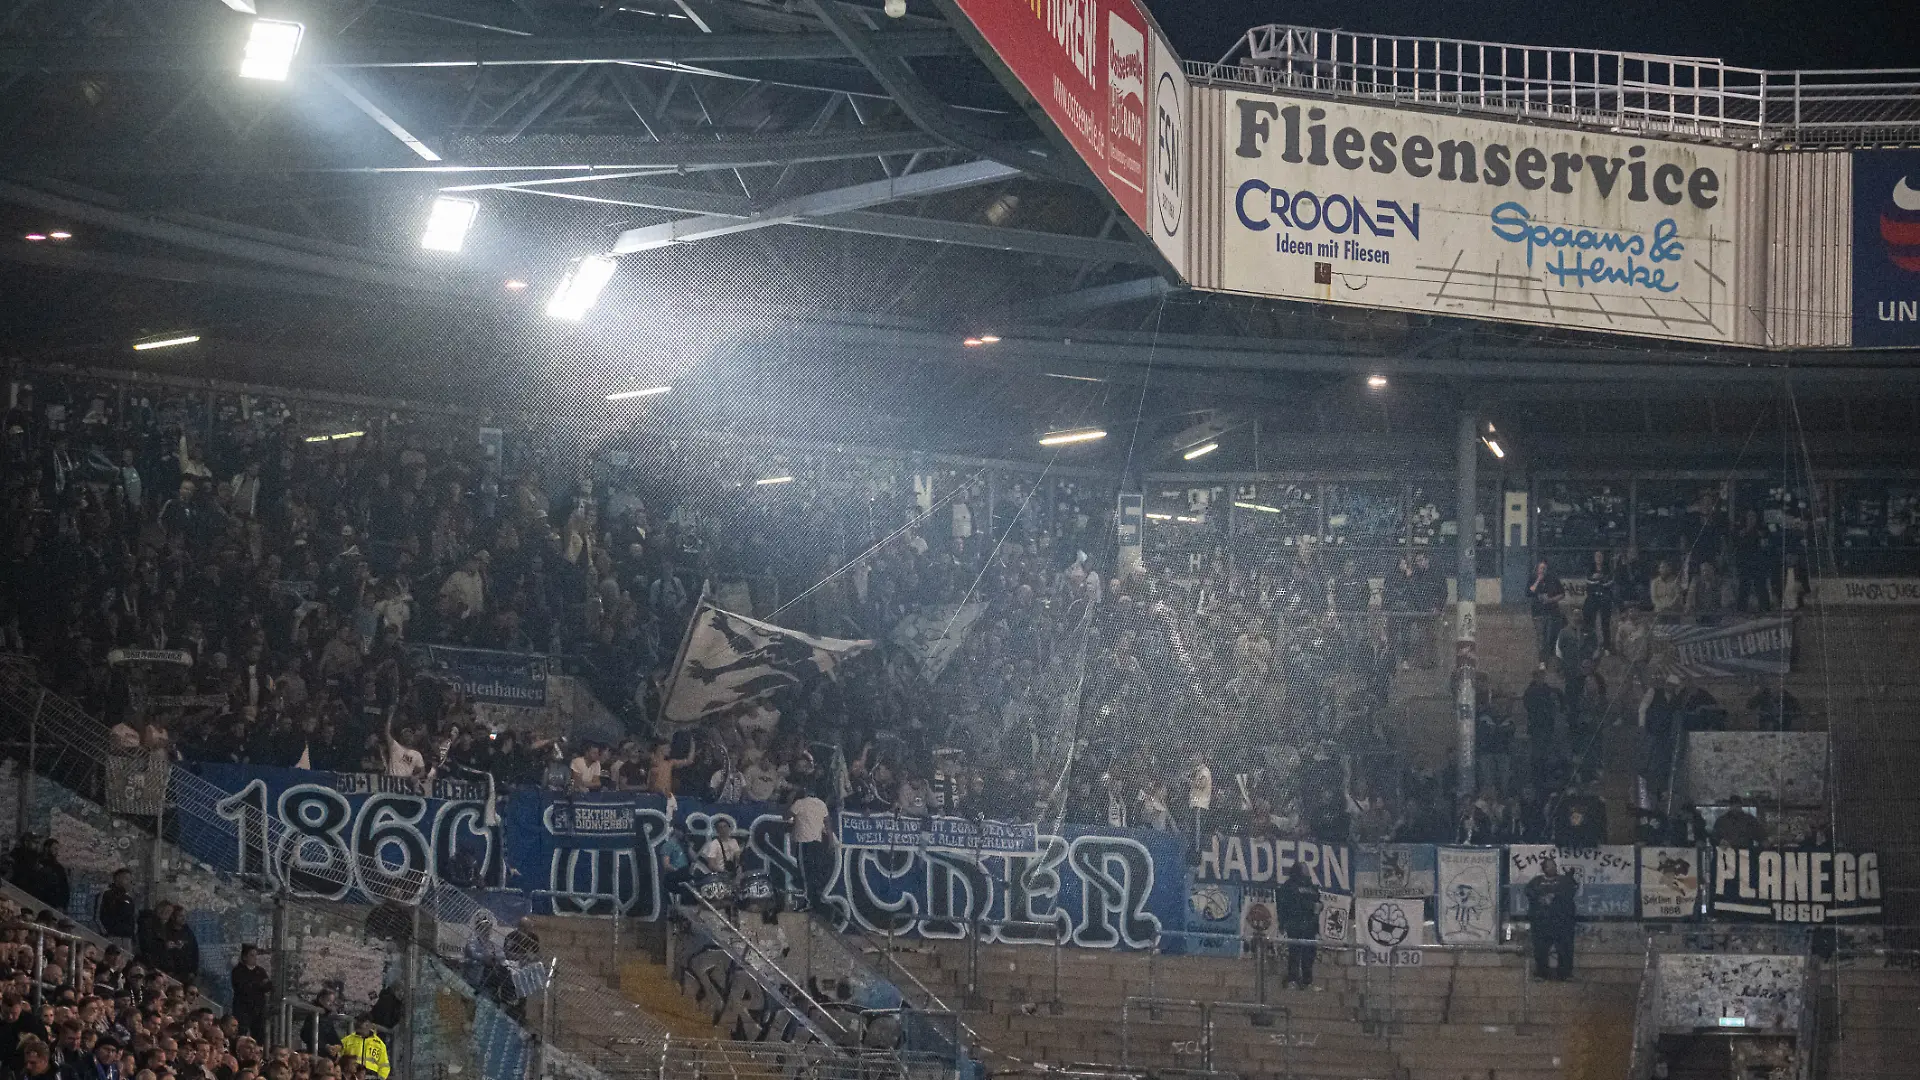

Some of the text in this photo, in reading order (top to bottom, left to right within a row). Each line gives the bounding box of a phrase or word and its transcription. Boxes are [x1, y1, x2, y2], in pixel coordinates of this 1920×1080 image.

[1158, 104, 1179, 198] FSN
[1235, 98, 1719, 209] Fliesenservice
[1235, 178, 1420, 241] CROONEN
[1490, 201, 1685, 269] Spaans &
[1276, 232, 1390, 265] Ideen mit Fliesen
[1545, 250, 1679, 293] Henke
[575, 808, 617, 820] SEKTION
[216, 778, 506, 906] 1860
[1199, 836, 1349, 889] HADERN
[1513, 848, 1632, 871] Engelsberger
[1714, 846, 1882, 903] PLANEGG
[1770, 902, 1827, 923] 1860
